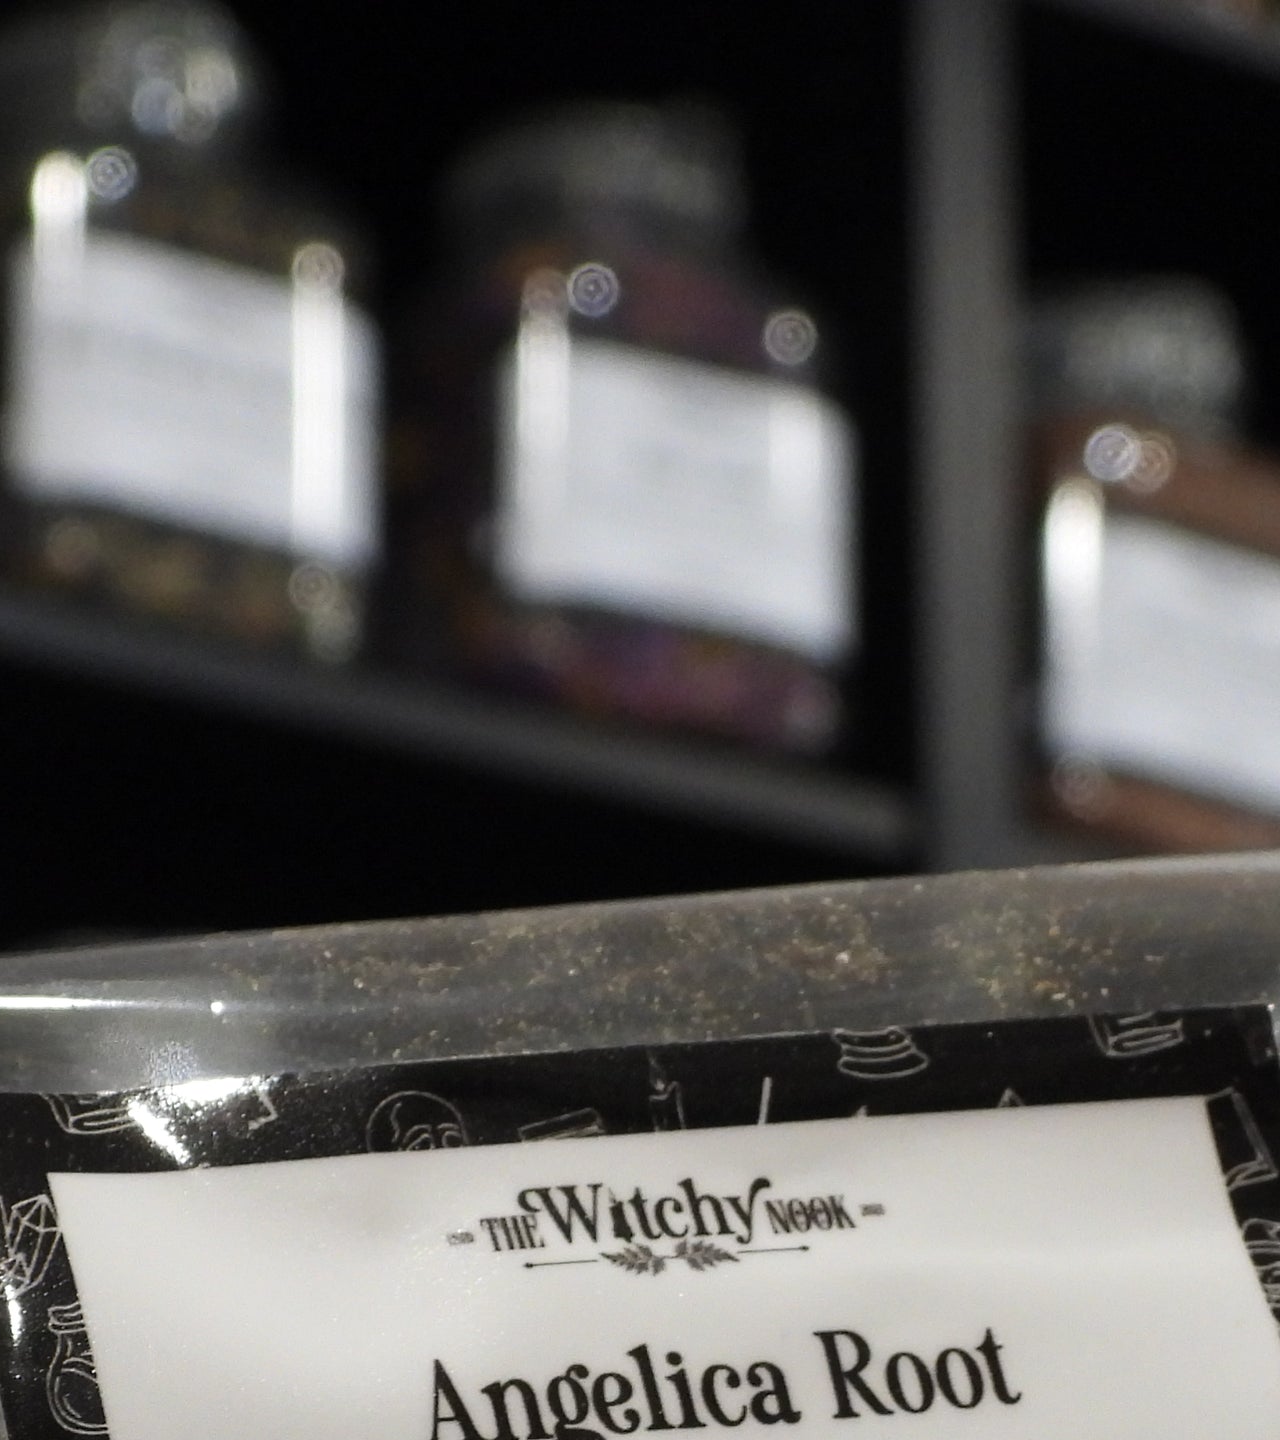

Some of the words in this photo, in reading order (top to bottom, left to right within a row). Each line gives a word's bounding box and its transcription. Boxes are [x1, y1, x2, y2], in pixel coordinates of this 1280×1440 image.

[479, 1213, 546, 1253] THE
[517, 1177, 773, 1246] Witchy
[765, 1194, 857, 1236] NOOK
[813, 1328, 1023, 1420] Root
